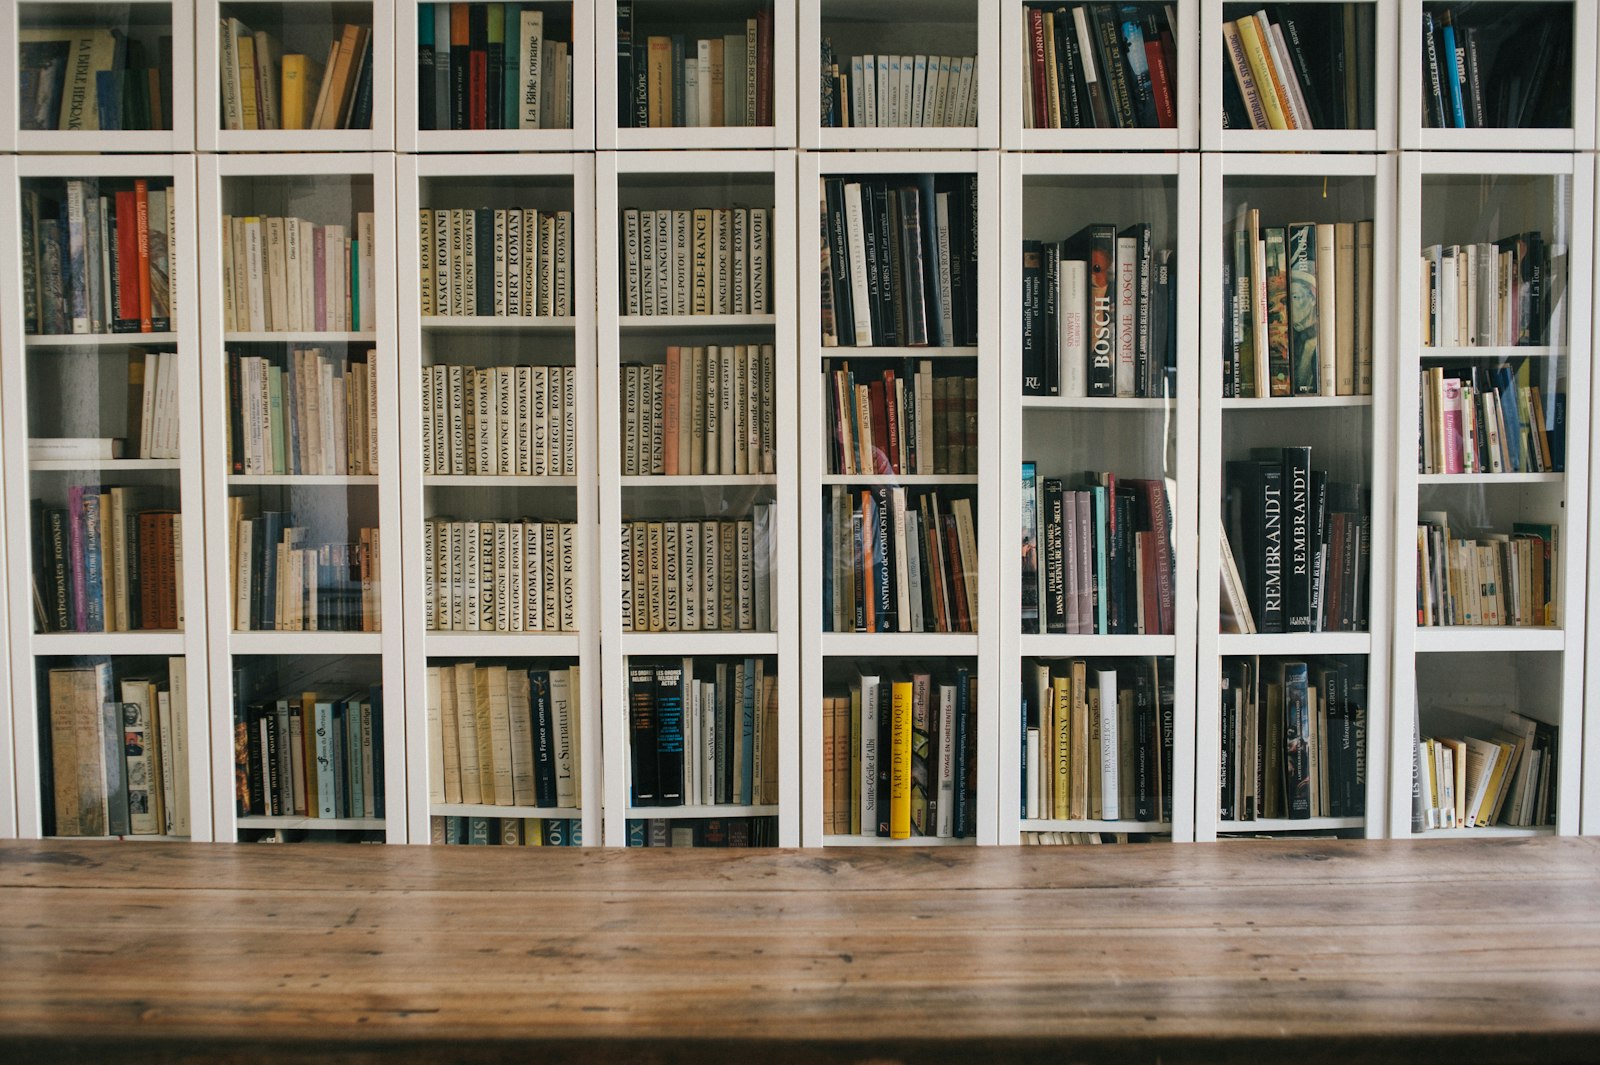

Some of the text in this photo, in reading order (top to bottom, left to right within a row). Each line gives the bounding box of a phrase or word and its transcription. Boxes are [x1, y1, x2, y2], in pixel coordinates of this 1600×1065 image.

[1034, 12, 1044, 62] LORRAINE
[1230, 34, 1250, 78] STRASBOURG
[526, 36, 538, 122] La Bible romane
[1107, 21, 1134, 128] LA CATHEDRALE DE METZ
[1245, 78, 1254, 88] DE
[1455, 48, 1466, 84] Rome
[420, 214, 430, 313] ALPES ROMANES
[438, 212, 448, 316] ALSACE ROMANE
[510, 214, 518, 314] BERRY ROMAN
[628, 214, 638, 314] FRANCHE-COMTÉ
[660, 213, 668, 315] HAUT-LANGUEDOC
[696, 214, 706, 313] ILE-DE-FRANCE
[754, 214, 762, 310] LYONNAIS SAVOIE
[940, 226, 948, 265] ROYAUME
[558, 268, 566, 317] CASTILLE
[870, 264, 878, 286] Vierge
[941, 267, 949, 284] SON
[942, 286, 950, 298] EN
[1024, 276, 1032, 306] flamands
[1238, 277, 1250, 314] BRUEGEL
[1532, 286, 1540, 296] La
[1024, 308, 1032, 336] Primitifs
[1094, 296, 1110, 368] BOSCH
[1120, 263, 1134, 365] JÉRÔME BOSCH
[654, 366, 663, 419] ROMANE
[708, 359, 716, 433] l'esprit de cluny
[750, 357, 759, 389] vézelay
[751, 392, 758, 402] de
[453, 368, 463, 472] PÉRIGORD ROMAN
[535, 371, 545, 475] QUERCY ROMAN
[627, 368, 636, 472] TOURAINE ROMANE
[862, 388, 870, 428] BESTIAIRES
[436, 413, 445, 470] NORMANDIE
[642, 441, 650, 454] DE
[751, 436, 758, 445] le
[889, 423, 897, 446] VIERGES
[88, 504, 96, 550] FLAMBOYANT
[1055, 538, 1062, 548] DU
[1294, 467, 1306, 575] REMBRANDT
[1361, 516, 1369, 555] RUBENS
[878, 500, 890, 610] SANTIAGO de COMPOSTELA
[1049, 562, 1056, 570] ET
[1153, 486, 1170, 608] BRUGES ET LA RENAISSANCE
[1266, 485, 1281, 612] REMBRANDT
[1313, 552, 1321, 576] RUBENS
[483, 528, 492, 624] ANGLETERRE
[528, 528, 536, 627] PRÉROMAN HISP
[546, 526, 554, 628] L'ART MOZARABE
[667, 526, 677, 627] SUISSE ROMANE
[1056, 584, 1063, 594] LA
[744, 674, 752, 737] VEZELAY
[944, 705, 952, 743] CHRÉTIENTÉS
[1092, 698, 1100, 728] Angelico
[1330, 706, 1336, 714] LE
[540, 752, 547, 762] La
[556, 699, 570, 779] Le Surnaturel
[894, 694, 903, 799] L'ART DU BAROQUE
[944, 744, 951, 752] EN
[1343, 714, 1351, 750] Velázquez
[1352, 710, 1364, 784] ZURBARÁN
[866, 738, 874, 811] Sainte-Cécile d'Albi
